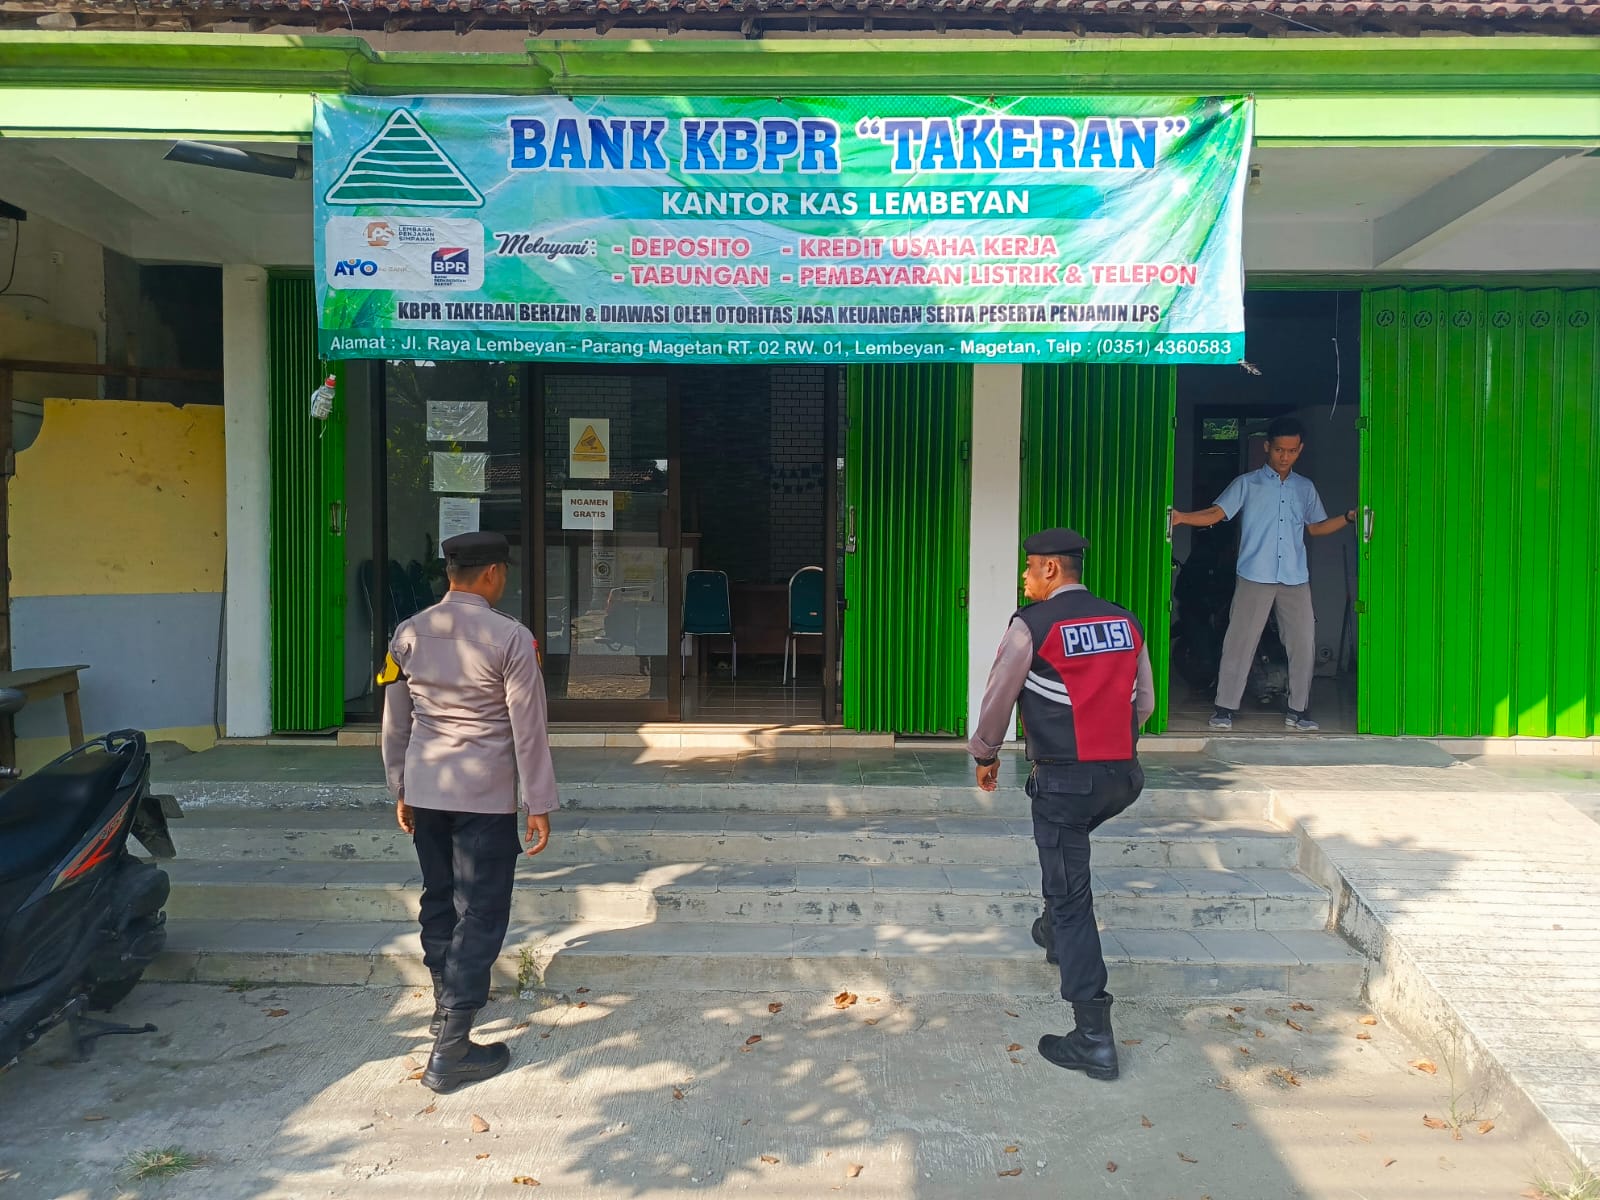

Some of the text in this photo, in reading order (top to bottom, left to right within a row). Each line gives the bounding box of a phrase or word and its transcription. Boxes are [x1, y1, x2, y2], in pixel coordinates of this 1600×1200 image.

[510, 118, 667, 170] BANK
[683, 120, 839, 170] KBPR
[662, 190, 1029, 216] KANTOR KAS LEMBEYAN
[631, 238, 751, 257] DEPOSITO
[800, 238, 884, 257] KREDIT
[892, 238, 977, 257] USAHA
[984, 237, 1057, 256] KERJA
[334, 258, 378, 276] AYO
[434, 261, 467, 272] BPR
[631, 266, 769, 285] TABUNGAN
[800, 266, 962, 285] PEMBAYARAN
[971, 265, 1059, 284] LISTRIK
[1065, 266, 1083, 283] &
[1092, 265, 1198, 285] TELEPON
[398, 302, 1160, 324] KBPR TAKERAN BERIZIN & DIAWASI OLEH OTORITAS JASA KEUANGAN SERTA PESERTA PENJAMIN LPS
[330, 335, 386, 350] Alamat
[401, 336, 421, 350] Jl.
[427, 336, 471, 353] Raya
[476, 337, 566, 355] Lembeyan
[581, 339, 644, 357] Parang
[648, 339, 723, 357] Magetan
[728, 340, 752, 355] RT.
[758, 341, 780, 355] 02
[785, 340, 818, 355] RW.
[823, 341, 849, 357] 01,
[855, 340, 945, 358] Lembeyan
[961, 339, 1041, 357] Magetan,
[1046, 338, 1082, 354] Telp
[1096, 338, 1150, 358] (0351)
[1154, 339, 1232, 355] 4360583
[570, 498, 608, 506] NGAMEN
[1064, 622, 1131, 653] POLISI
